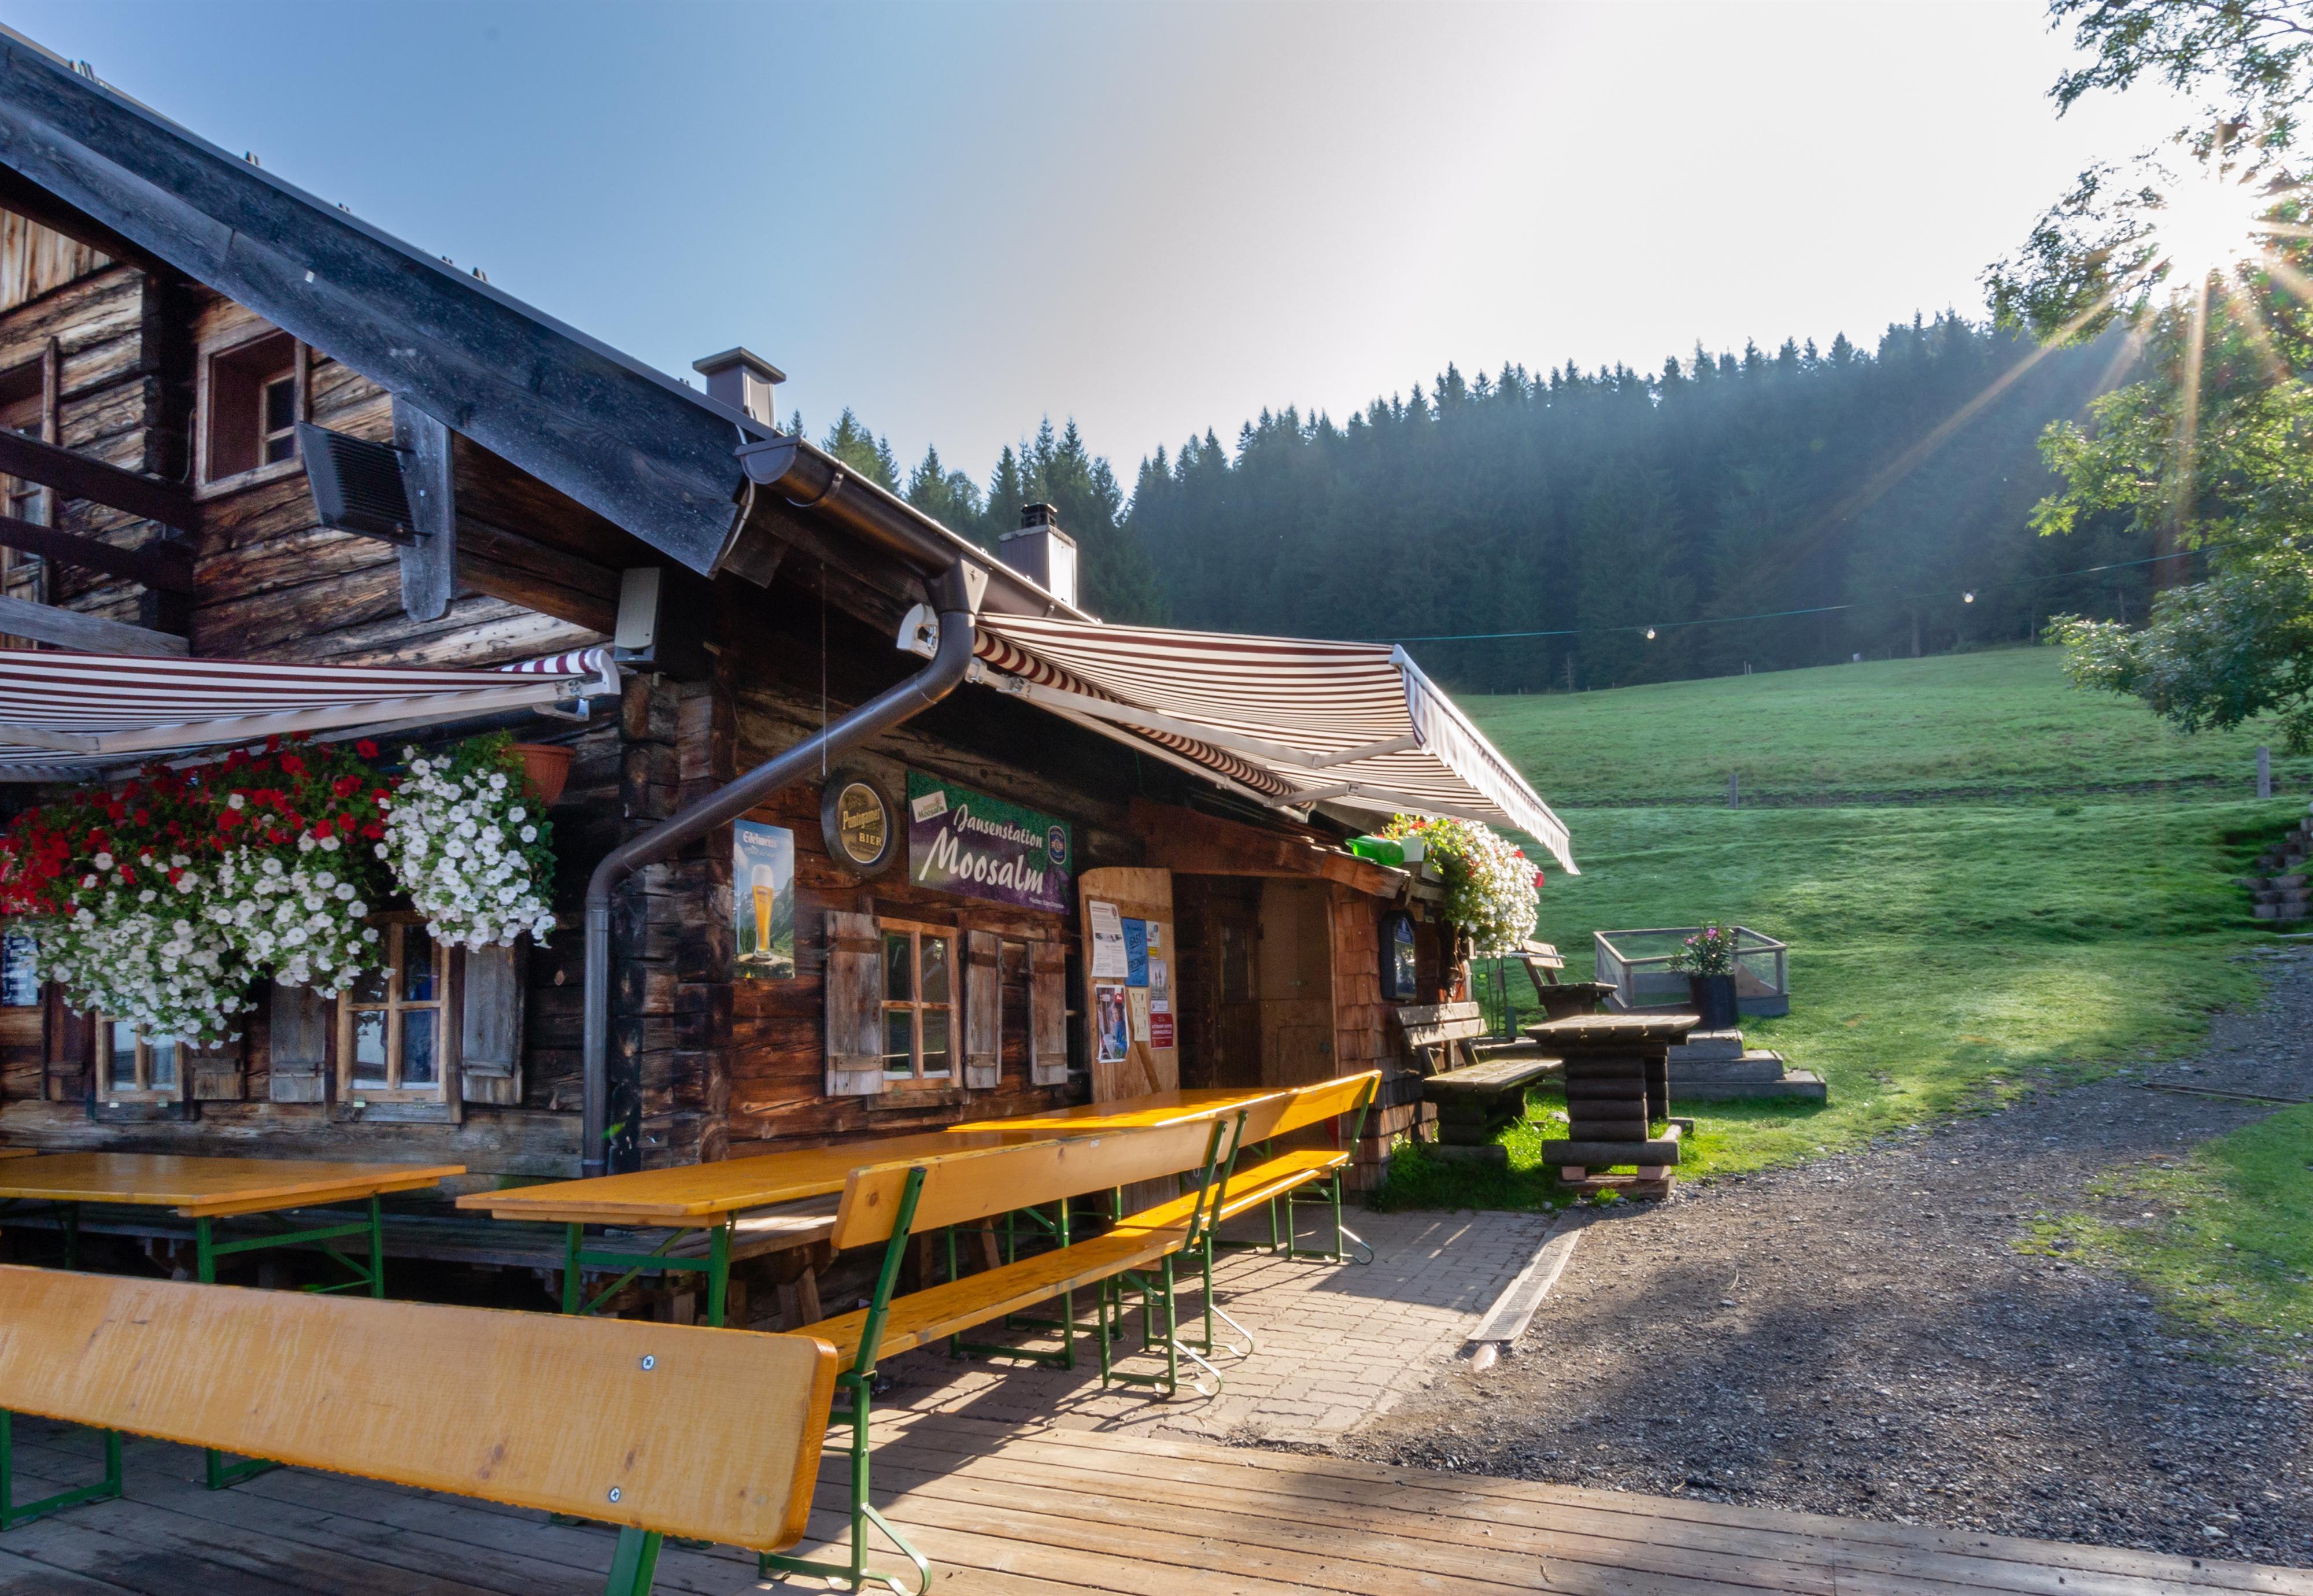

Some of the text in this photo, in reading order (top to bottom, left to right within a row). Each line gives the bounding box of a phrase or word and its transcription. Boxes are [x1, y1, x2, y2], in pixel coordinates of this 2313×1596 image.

[843, 808, 880, 830] Puntigamer
[954, 804, 1043, 848] Jausenstation
[859, 832, 882, 847] BIER
[918, 826, 1043, 894] Moosalm
